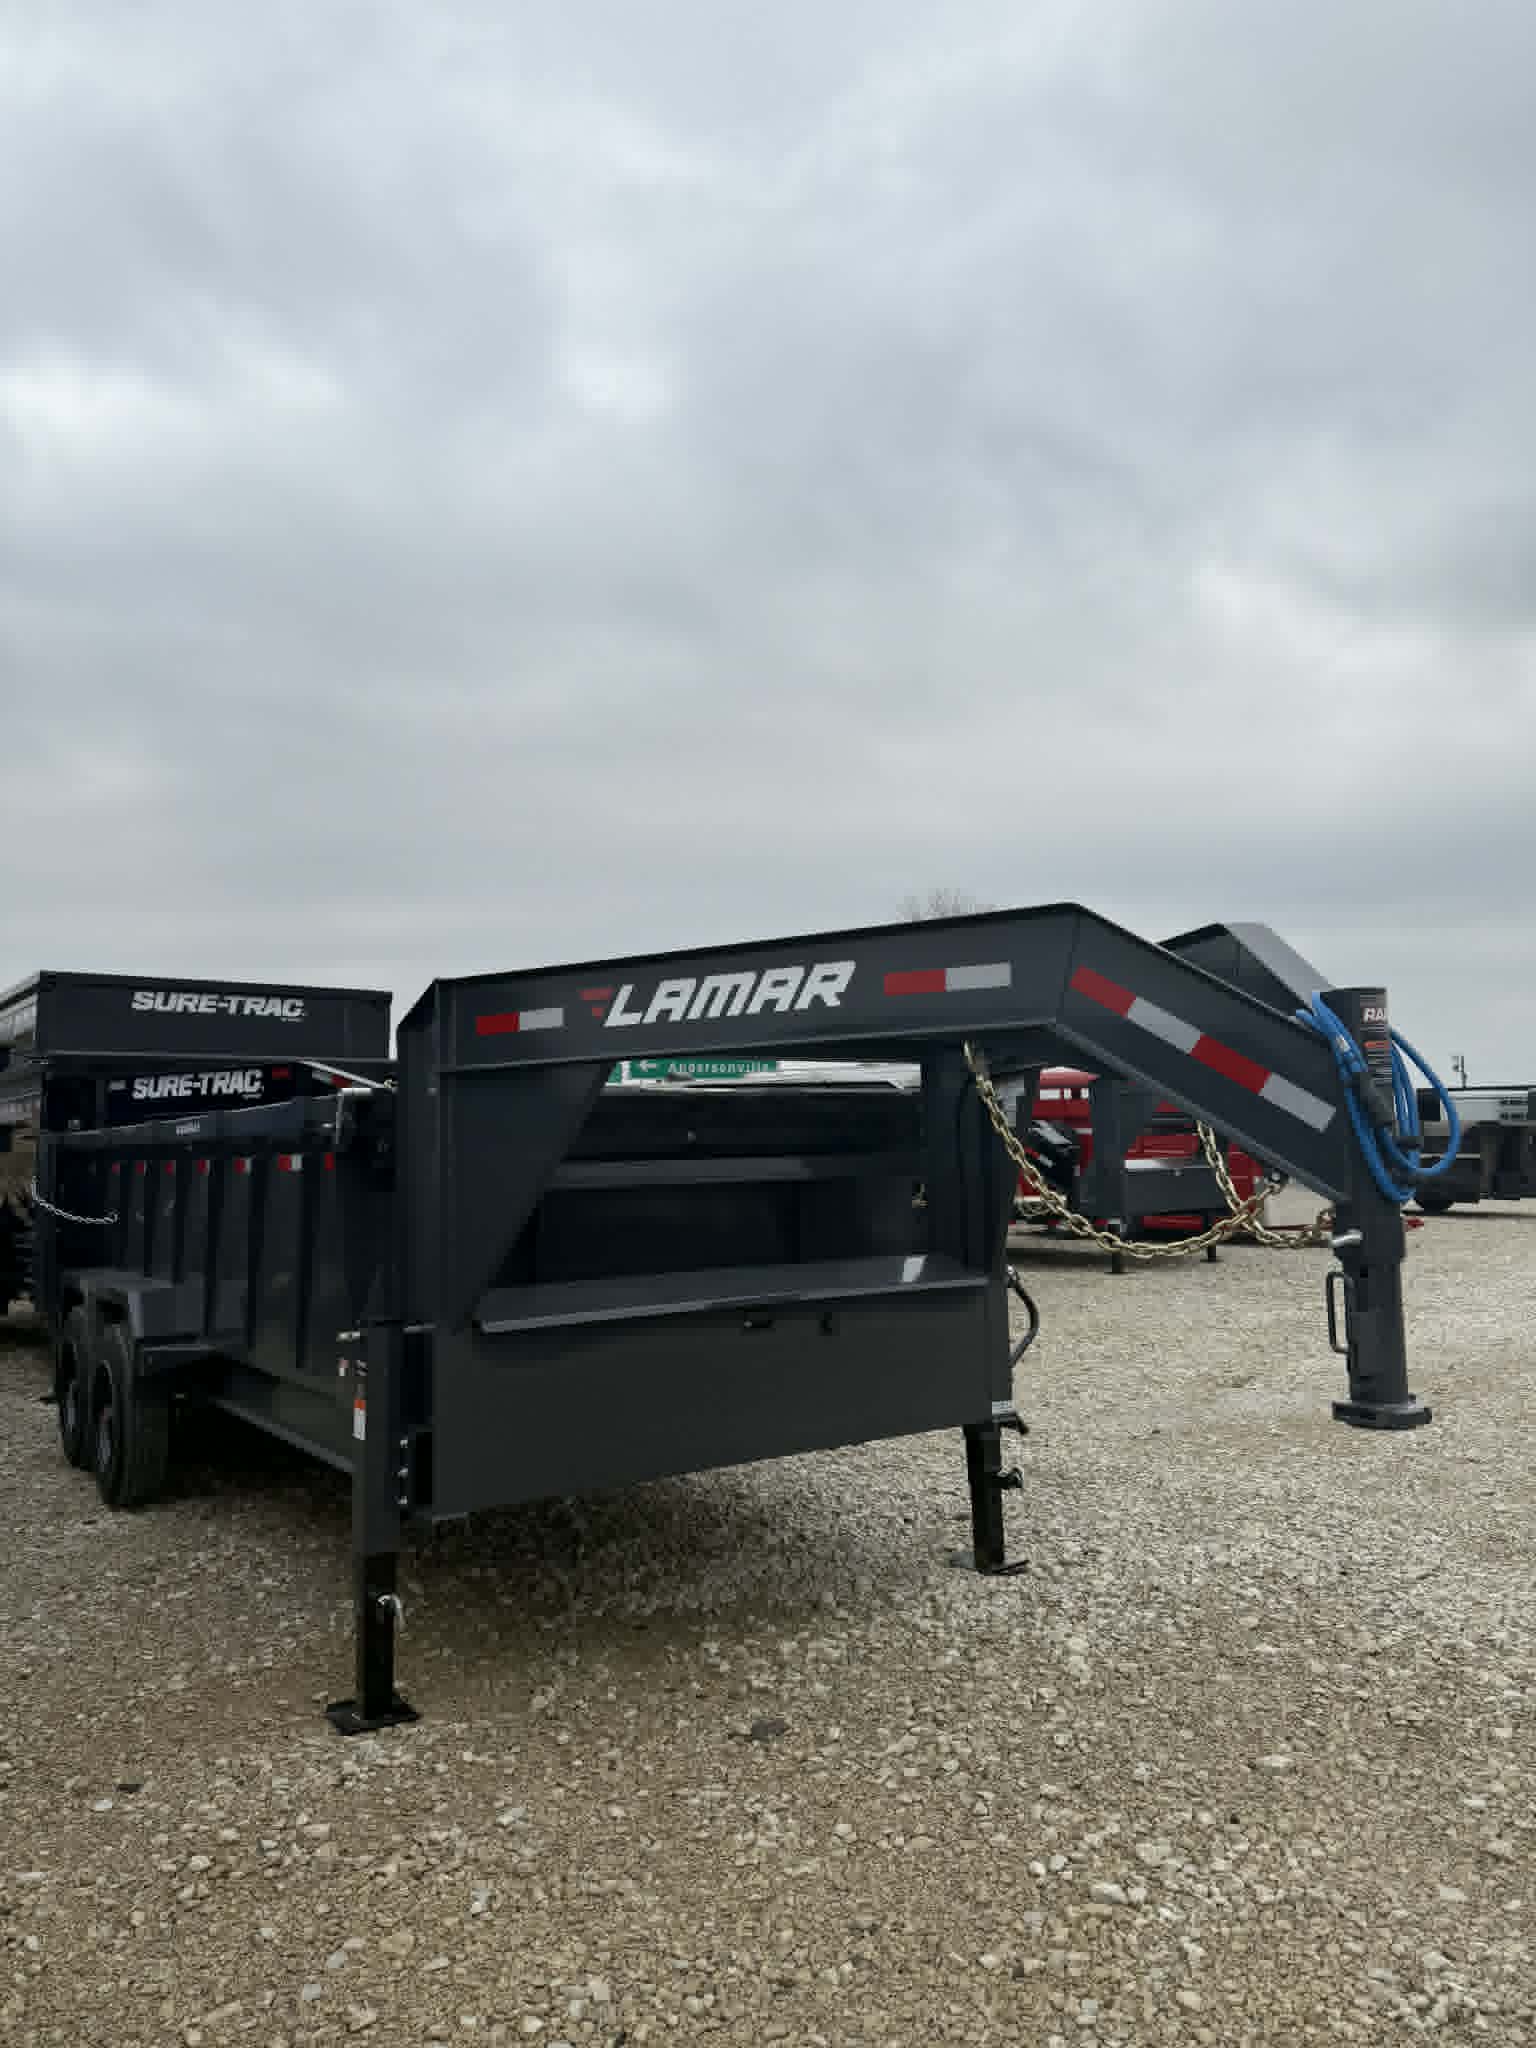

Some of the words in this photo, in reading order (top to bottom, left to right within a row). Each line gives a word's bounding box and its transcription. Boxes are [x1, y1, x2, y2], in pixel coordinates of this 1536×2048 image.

[131, 992, 305, 1018] SURE-TRAC
[603, 960, 856, 1027] LAMAR
[1363, 1008, 1387, 1024] RA
[667, 1058, 769, 1073] Andersonville
[132, 1069, 264, 1099] SURE-TRAC
